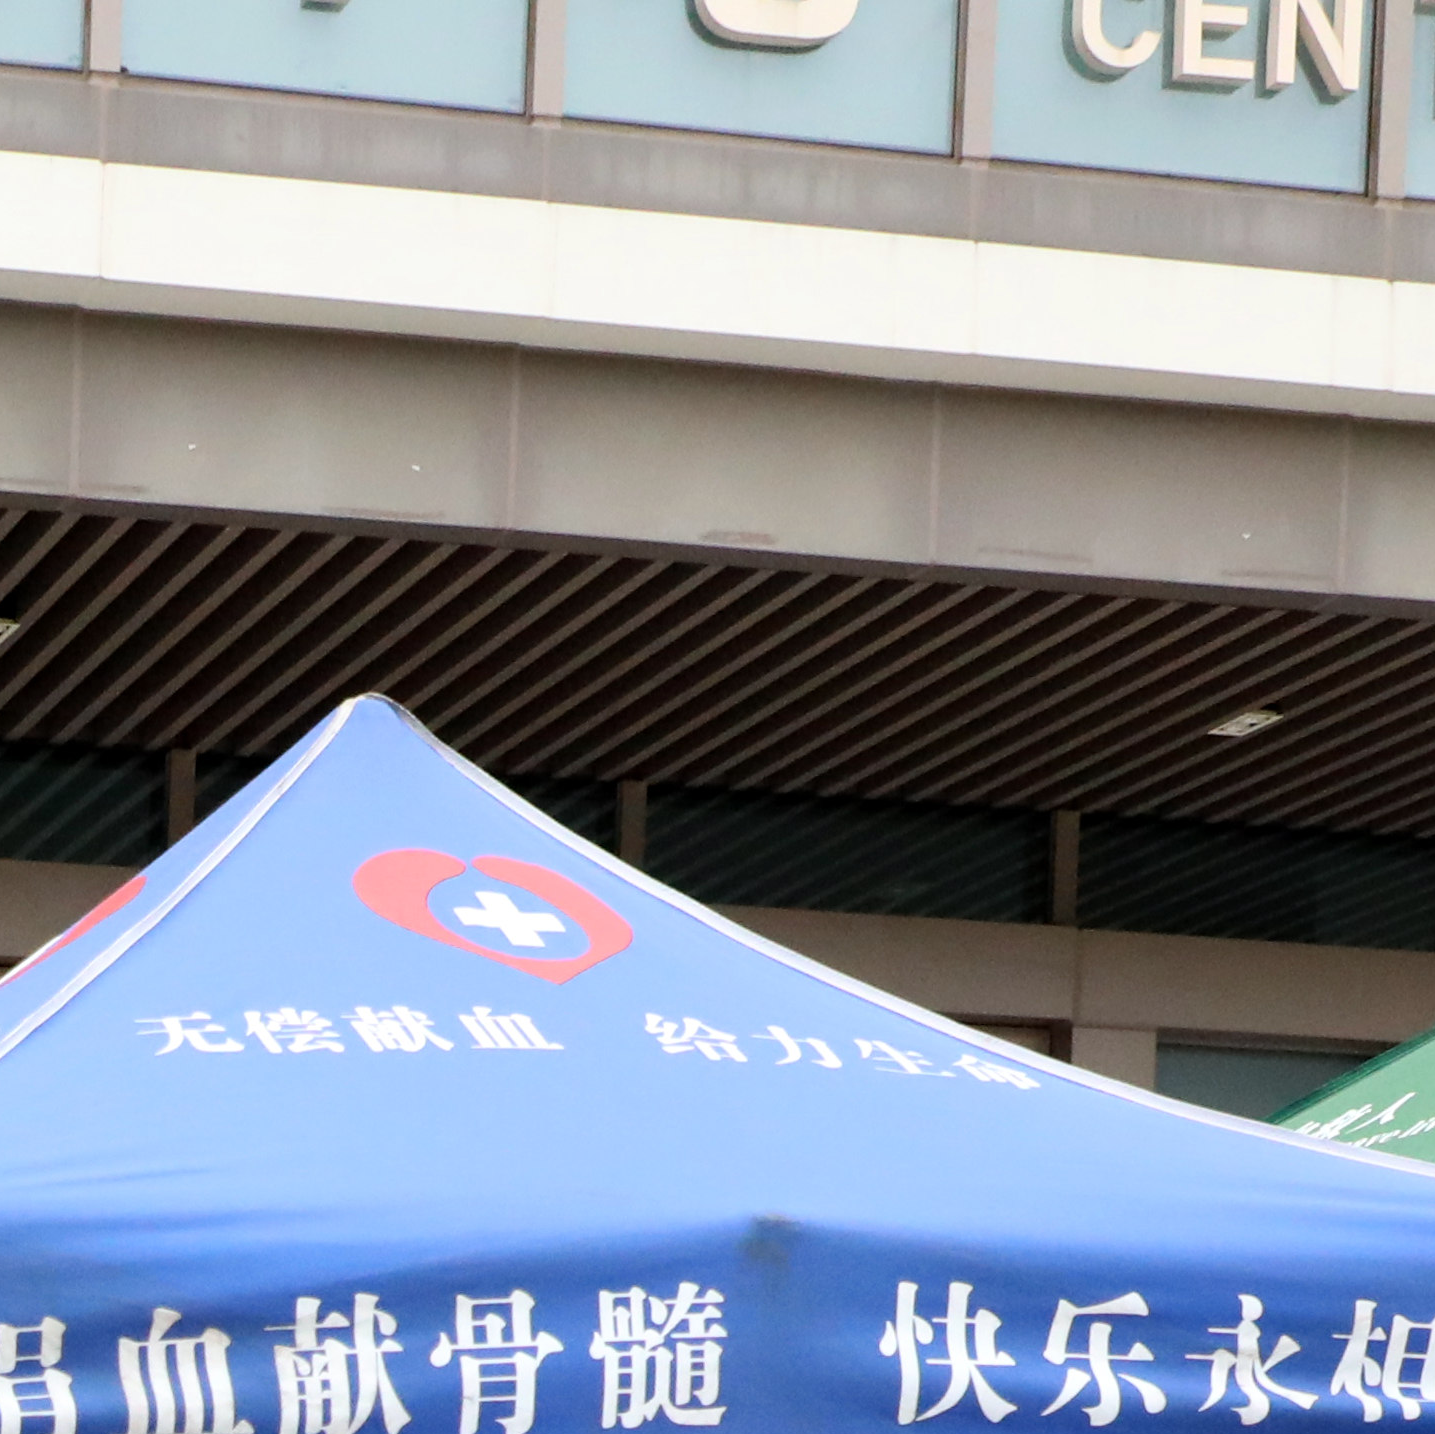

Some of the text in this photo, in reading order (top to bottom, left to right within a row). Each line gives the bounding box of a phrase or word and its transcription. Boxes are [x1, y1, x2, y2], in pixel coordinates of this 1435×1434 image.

[133, 1004, 1042, 1093] 无偿献血 给力生命
